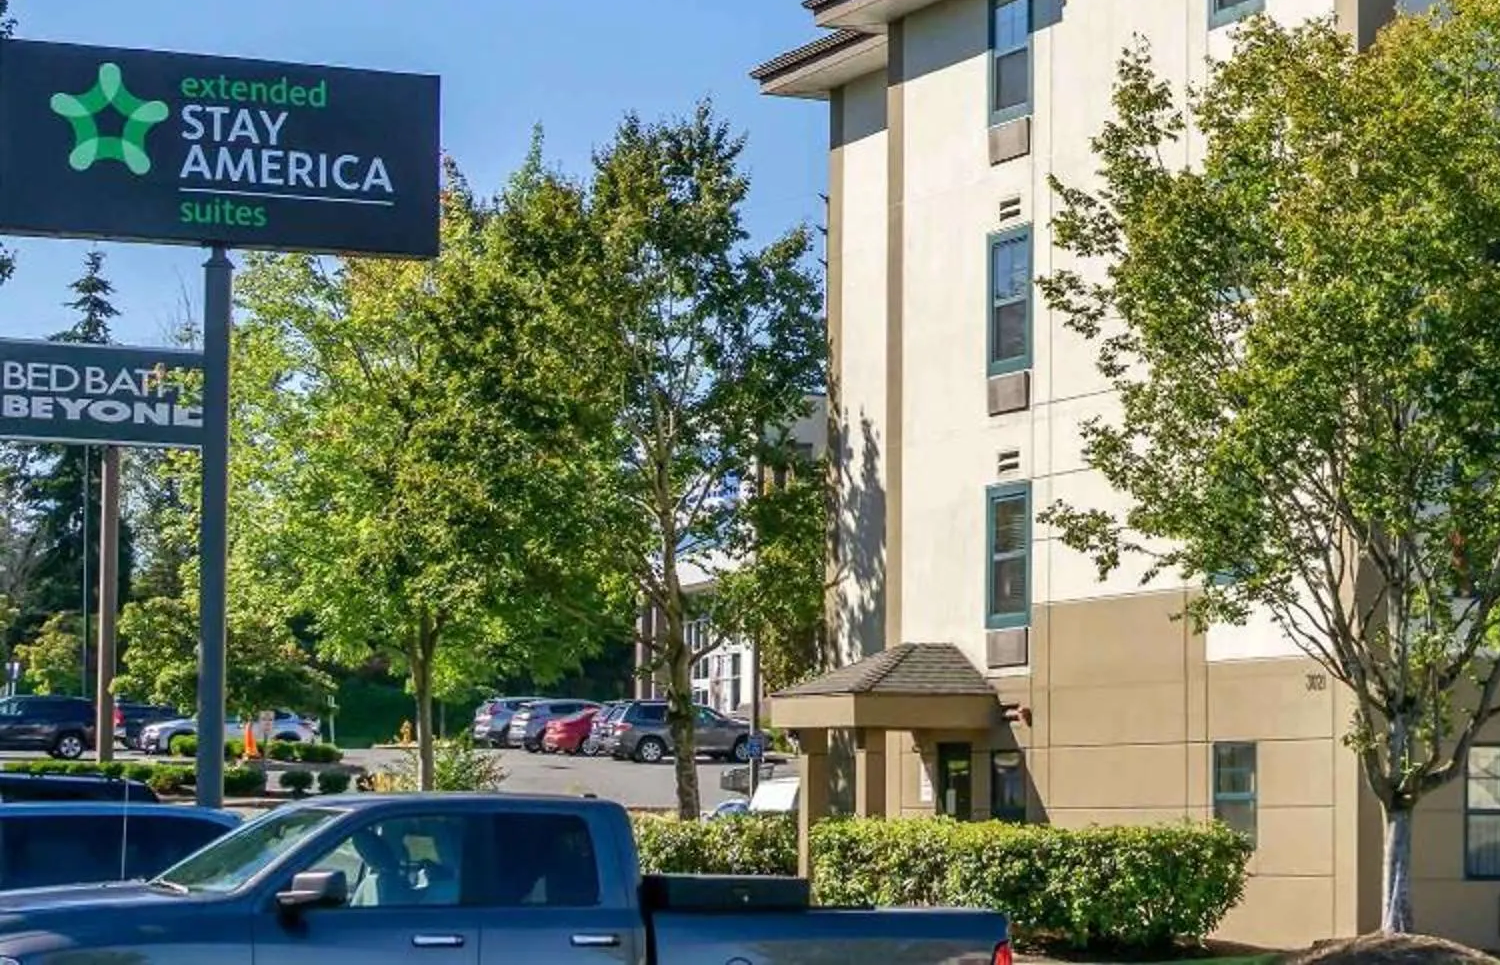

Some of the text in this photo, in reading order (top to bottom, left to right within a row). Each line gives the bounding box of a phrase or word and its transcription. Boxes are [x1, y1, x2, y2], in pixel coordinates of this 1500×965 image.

[181, 74, 327, 108] extended
[181, 104, 289, 146] STAY
[179, 145, 395, 193] AMERICA
[180, 198, 267, 227] suites
[3, 361, 81, 392] BED
